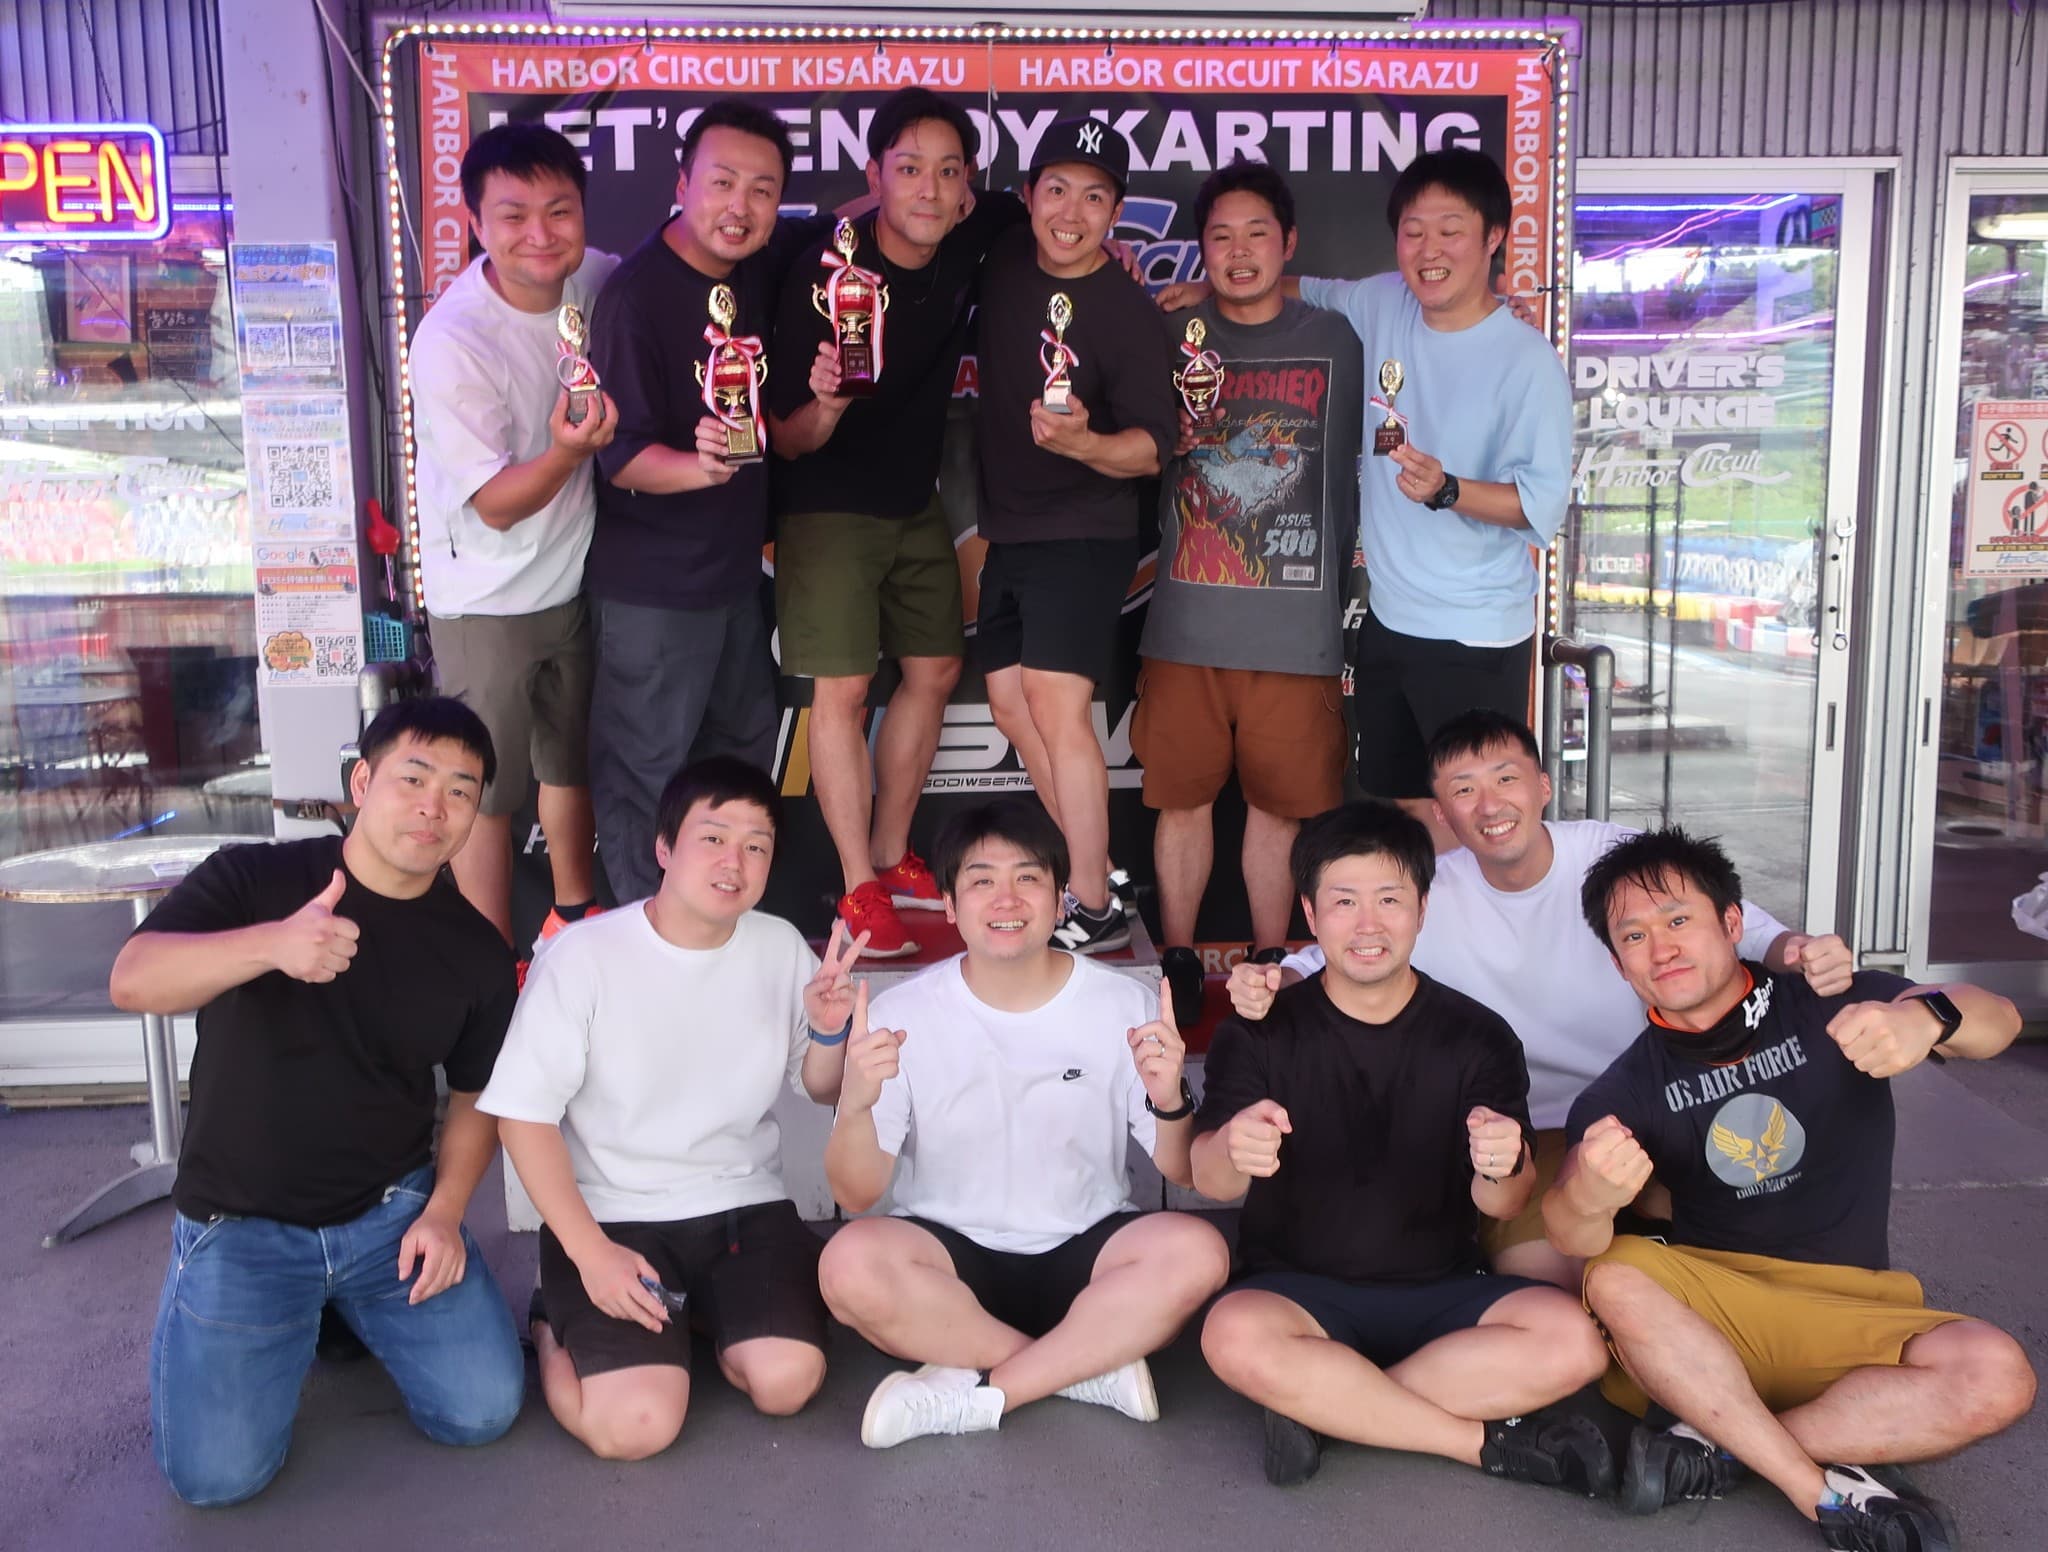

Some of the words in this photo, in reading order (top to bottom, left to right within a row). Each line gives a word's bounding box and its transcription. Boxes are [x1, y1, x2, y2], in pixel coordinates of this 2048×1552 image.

[492, 56, 637, 88] HARBOR
[649, 55, 781, 87] CIRCUIT
[792, 56, 966, 86] KISARAZU
[1020, 57, 1164, 87] HARBOR
[1175, 58, 1301, 88] CIRCUIT
[1311, 59, 1479, 90] KISARAZU
[431, 53, 461, 209] HARBOR
[1089, 109, 1482, 173] KARTING
[1513, 57, 1543, 206] HARBOR
[1575, 356, 1786, 389] DRIVER'S
[1590, 397, 1776, 430] LOUNGE
[1572, 446, 1682, 488] Harbor
[1680, 442, 1792, 487] Circuit
[1274, 513, 1313, 527] ISSUE
[257, 547, 305, 563] Google
[1262, 527, 1317, 558] 500
[1743, 1035, 1808, 1086] FORCE
